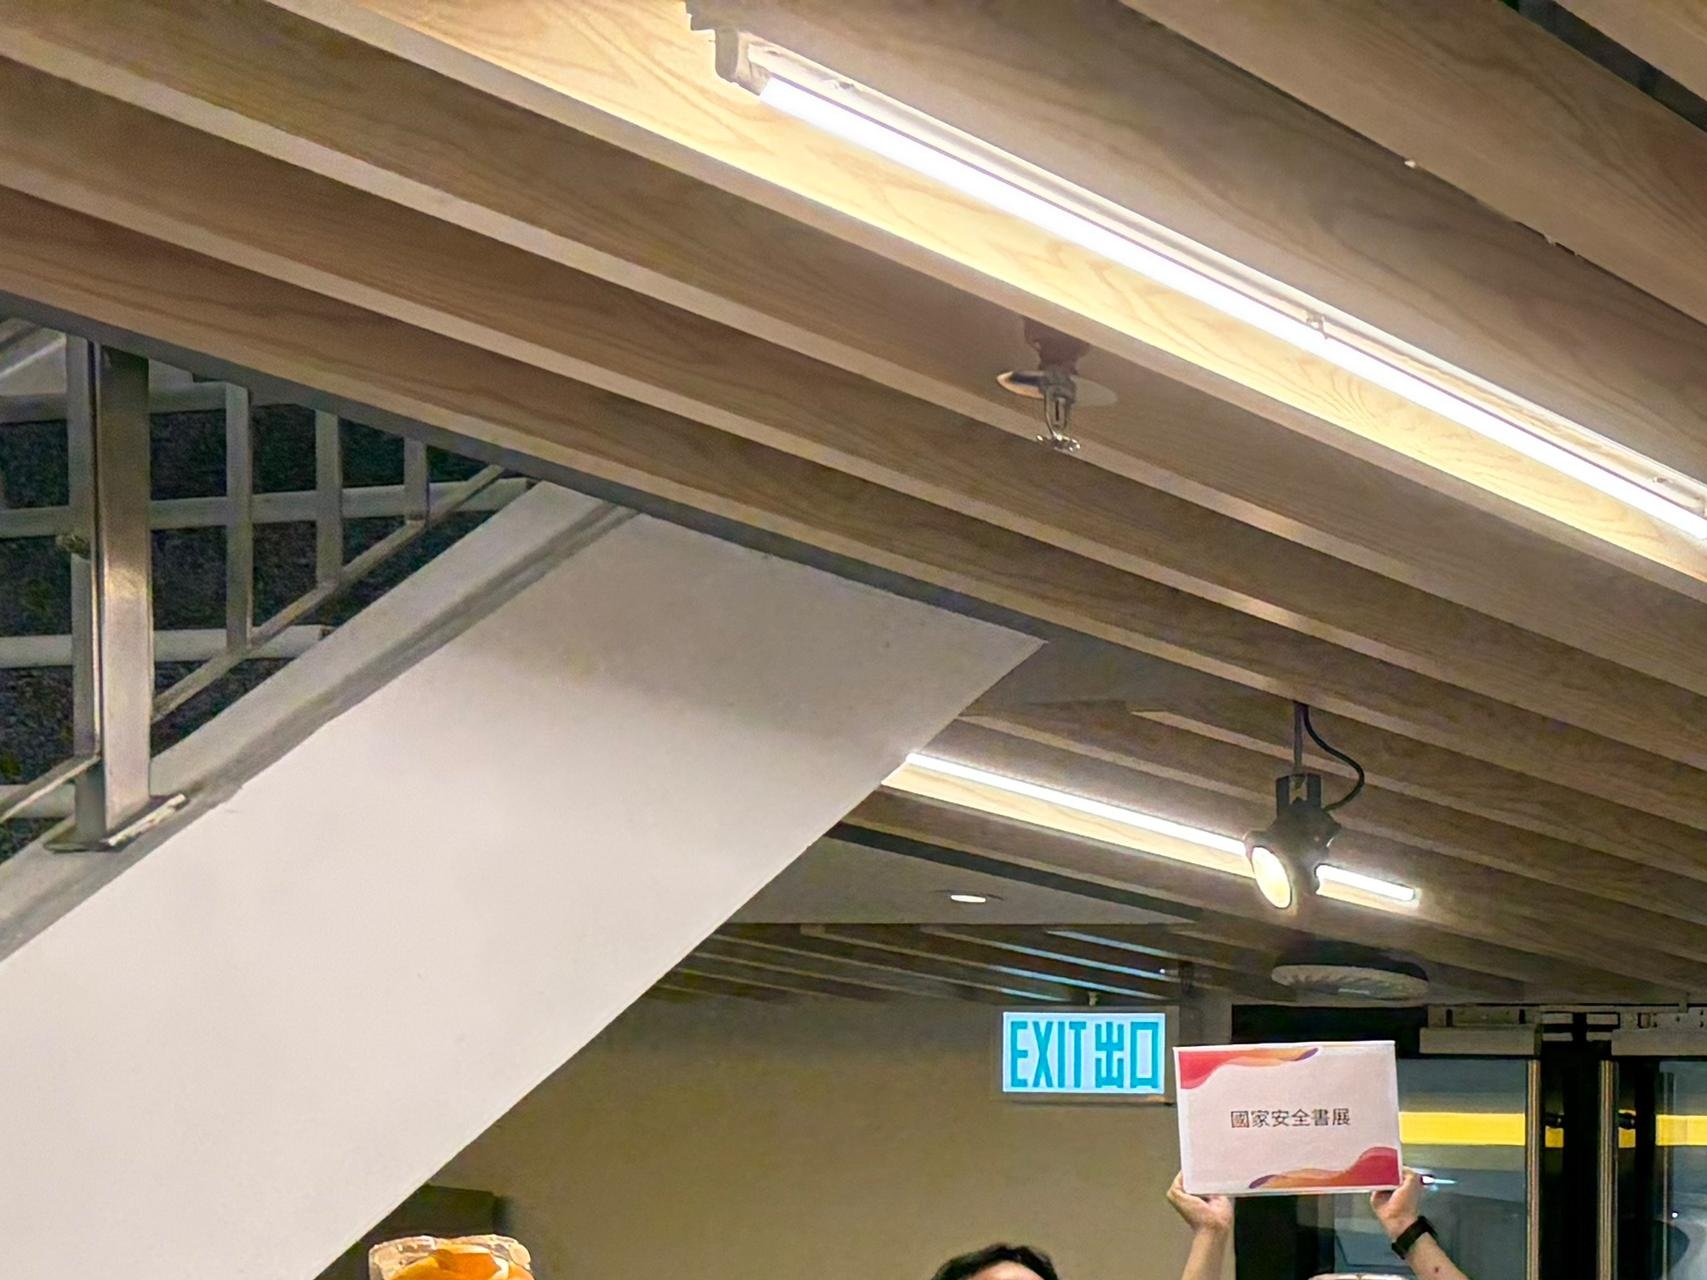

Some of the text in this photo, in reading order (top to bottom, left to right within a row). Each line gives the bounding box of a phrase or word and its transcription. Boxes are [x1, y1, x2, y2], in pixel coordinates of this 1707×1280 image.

[1010, 1021, 1086, 1088] EXIT
[1095, 1021, 1159, 1089] 出口
[1230, 1107, 1351, 1129] 國家安全書展
